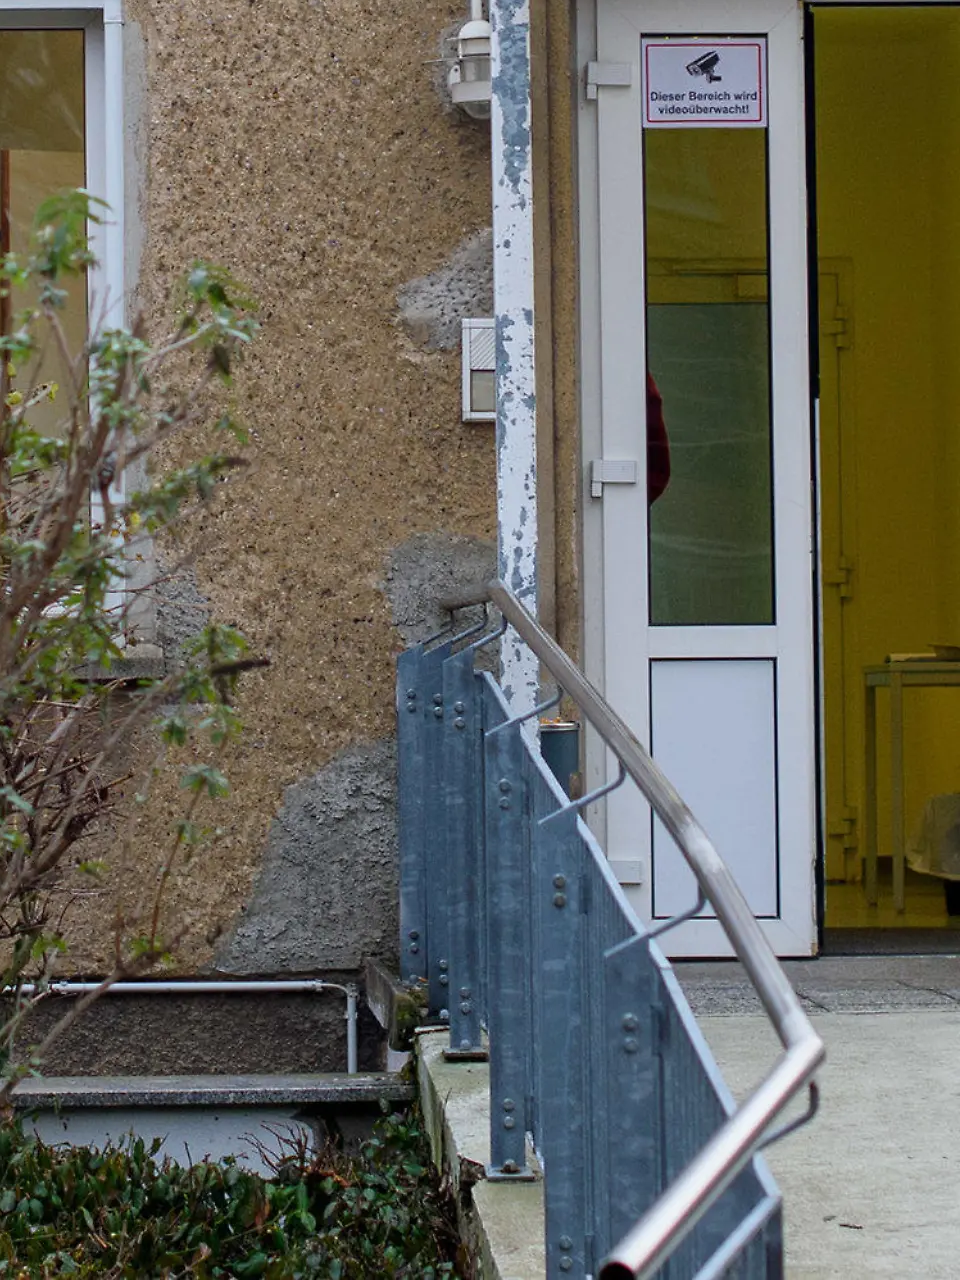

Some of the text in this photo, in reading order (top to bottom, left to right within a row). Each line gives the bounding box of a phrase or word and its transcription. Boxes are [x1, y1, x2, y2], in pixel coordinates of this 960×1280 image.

[650, 91, 758, 102] Dieser Bereich wird
[658, 104, 750, 115] videoüberwacht!
